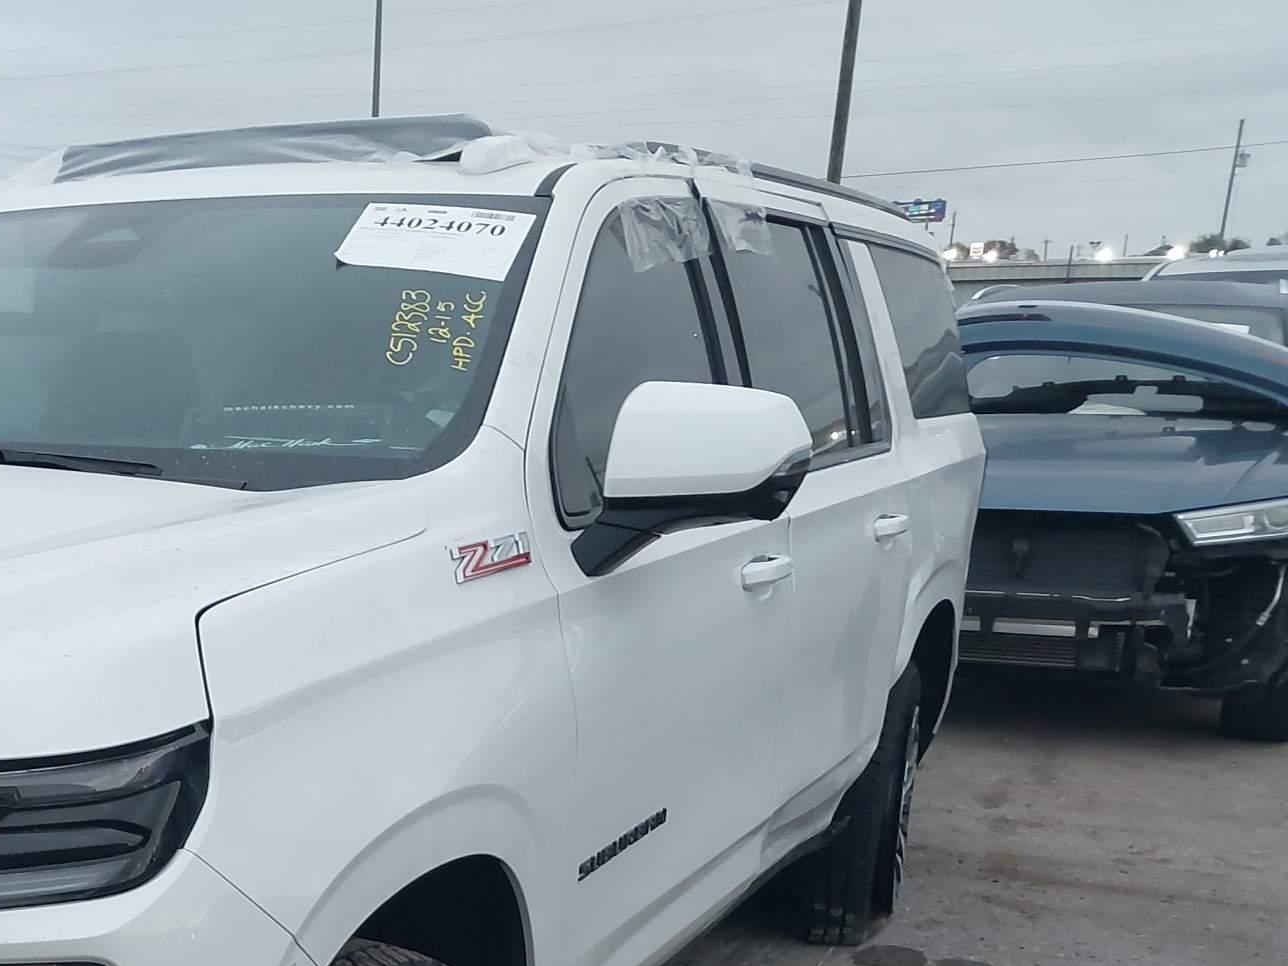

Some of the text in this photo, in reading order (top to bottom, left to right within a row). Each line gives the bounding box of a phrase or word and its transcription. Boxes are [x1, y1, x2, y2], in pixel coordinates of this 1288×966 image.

[373, 215, 506, 238] 44024070
[461, 290, 488, 329] ACC
[223, 403, 355, 412] machaikchevycom
[449, 531, 532, 585] Z71
